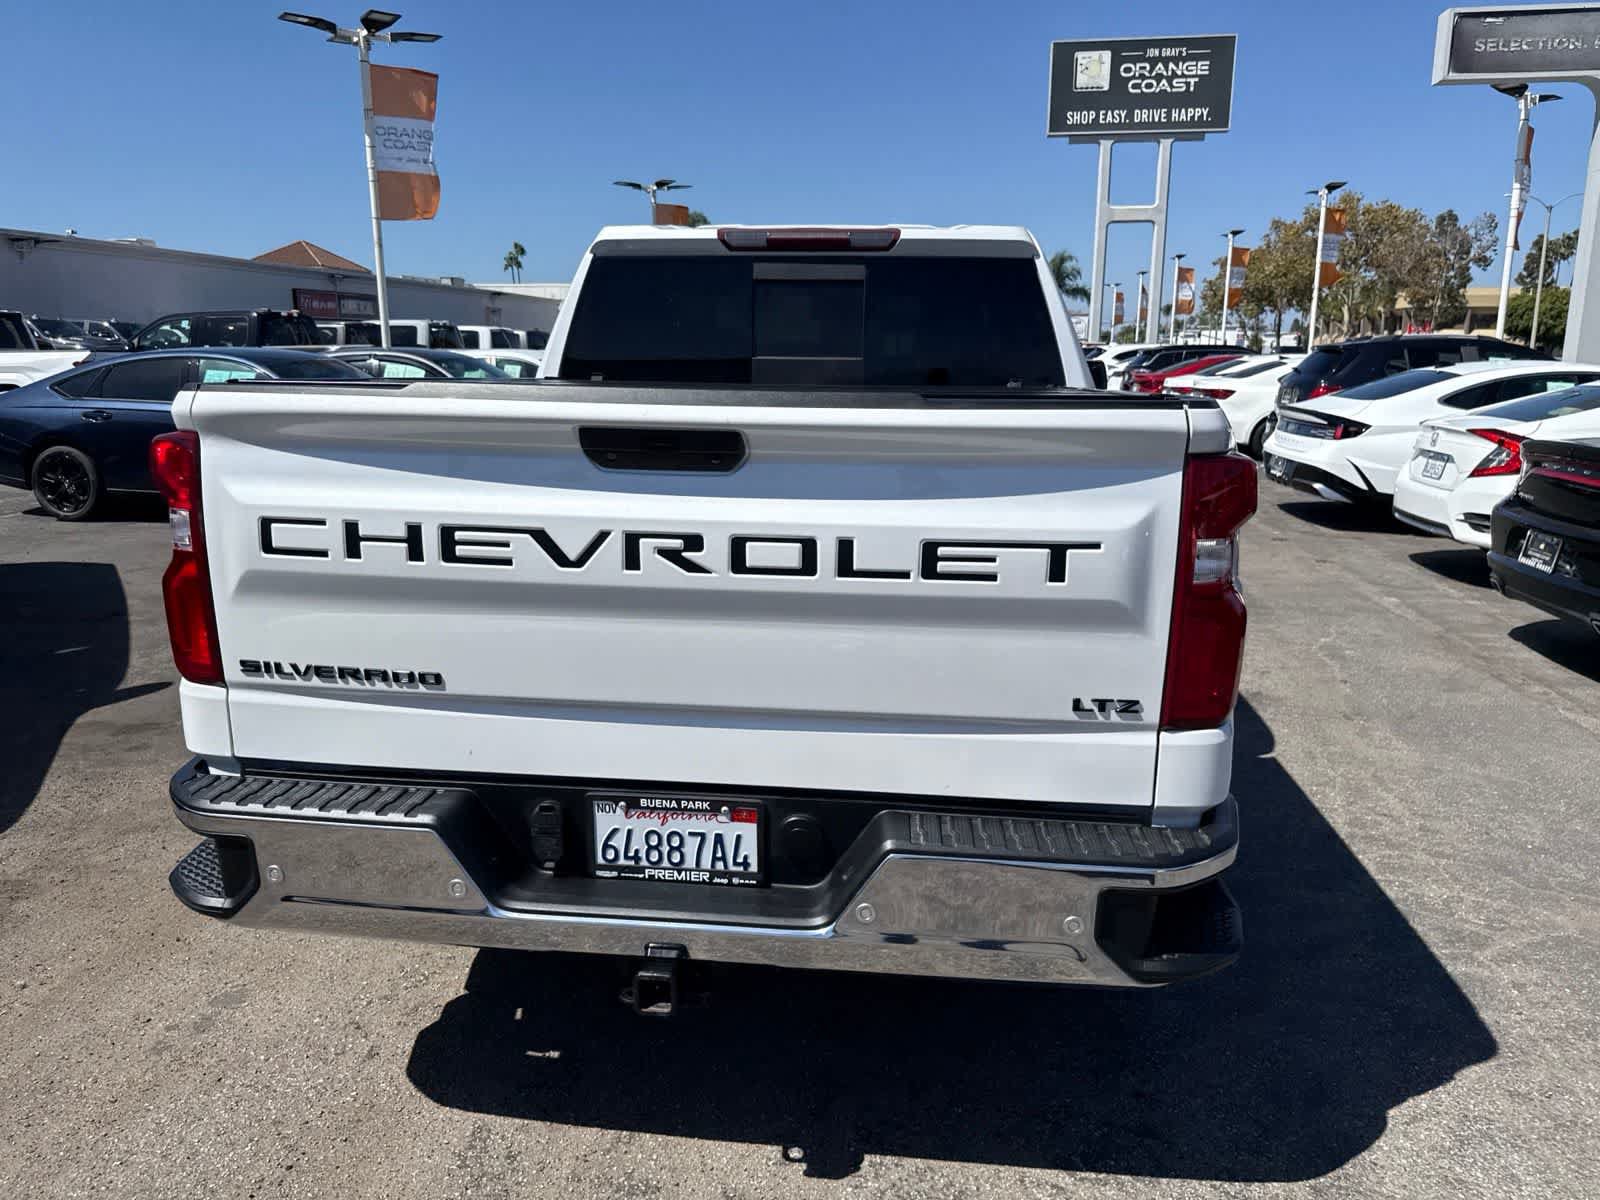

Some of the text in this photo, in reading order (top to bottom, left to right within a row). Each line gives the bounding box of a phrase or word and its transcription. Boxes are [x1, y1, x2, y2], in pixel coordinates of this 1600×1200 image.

[1145, 47, 1187, 57] JON GRAY'S
[1474, 38, 1587, 52] SELECTION.
[1119, 61, 1210, 77] ORANGE
[1127, 78, 1199, 93] COAST
[1066, 107, 1212, 125] SHOP EASY. DRIVE HAPPY.
[375, 125, 434, 141] ORANG
[259, 515, 1103, 585] CHEVROLET
[239, 659, 444, 686] SILVERADO
[1071, 697, 1141, 714] LTZ
[596, 802, 618, 814] NOV
[640, 799, 711, 810] BUENA PARK
[600, 827, 751, 871] 64887A4
[644, 868, 710, 883] PREMIER
